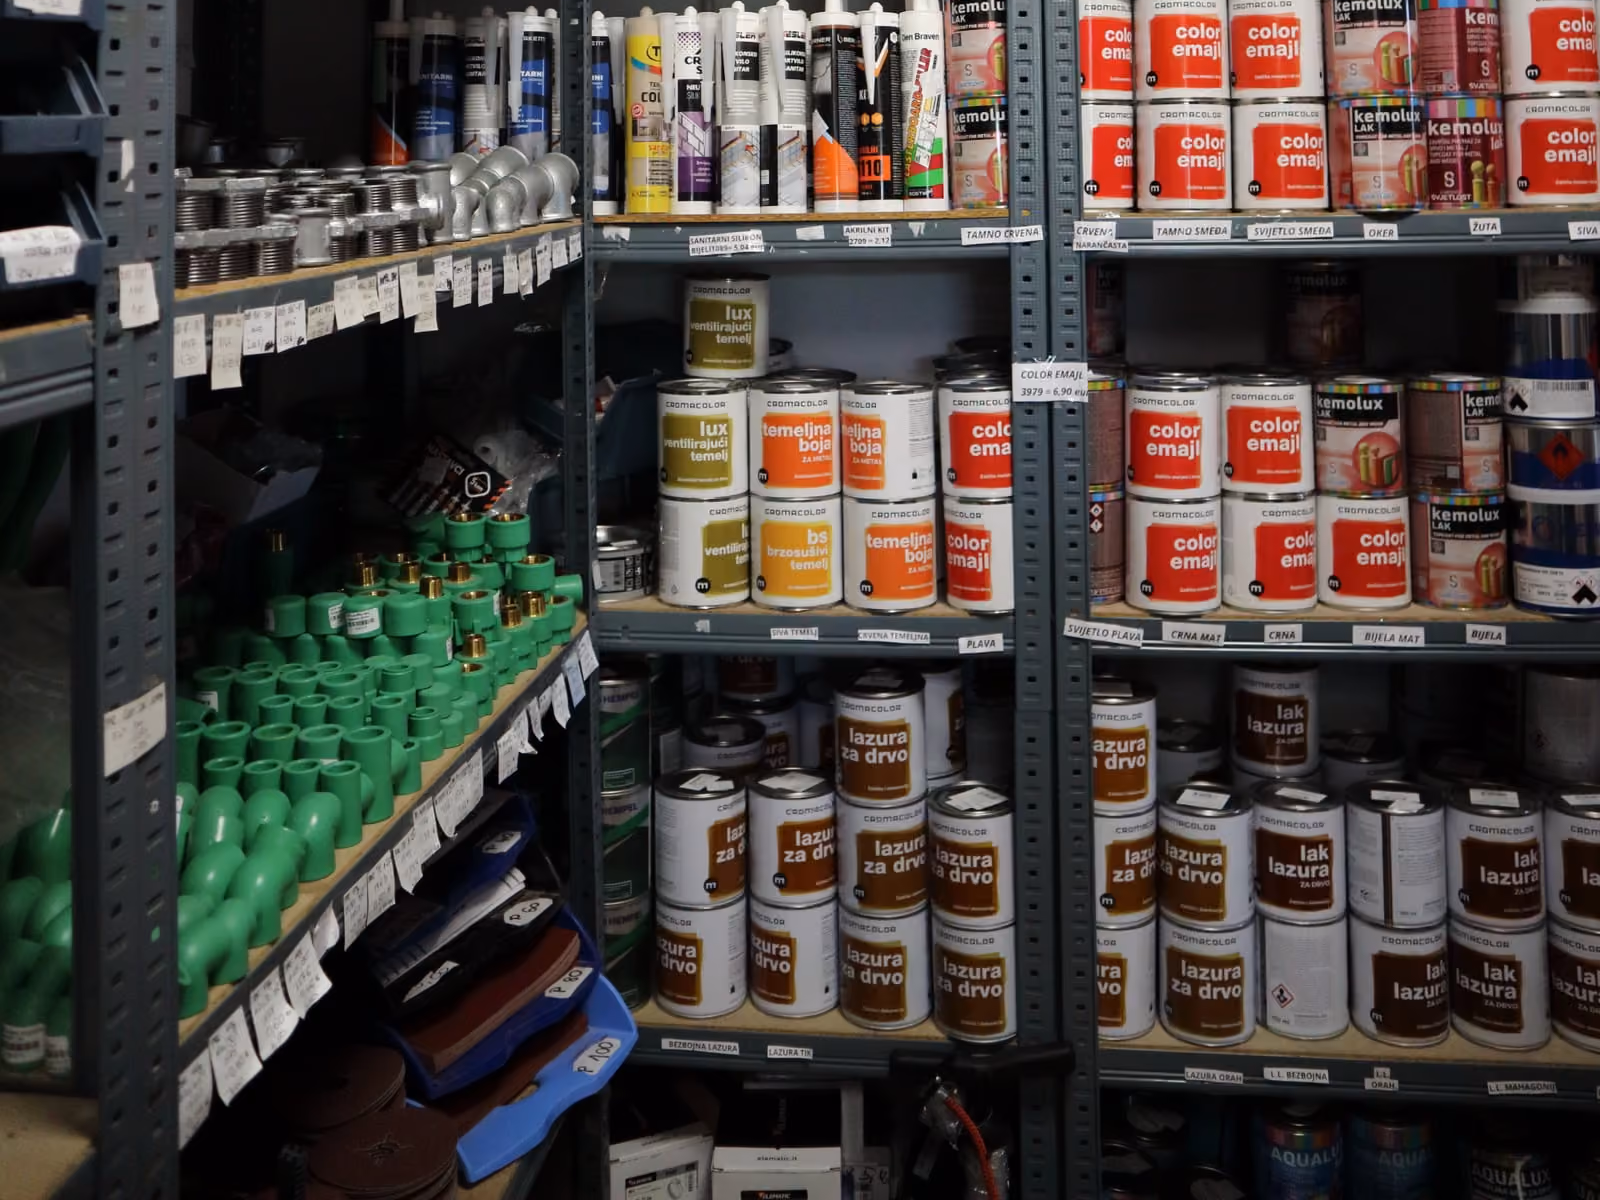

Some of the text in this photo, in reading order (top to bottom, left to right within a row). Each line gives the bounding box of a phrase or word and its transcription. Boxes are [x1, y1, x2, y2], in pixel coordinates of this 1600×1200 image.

[914, 32, 940, 41] Braven
[1175, 23, 1221, 41] color
[1248, 23, 1299, 41] color
[1172, 42, 1222, 61] emajl
[1245, 42, 1300, 61] emajl
[953, 108, 1006, 125] kemolu
[1353, 109, 1421, 123] kemolux
[1353, 123, 1375, 133] LAK
[1547, 128, 1596, 145] color
[1180, 133, 1225, 150] color
[1280, 133, 1323, 151] color
[967, 227, 1040, 239] TAMNO CRVENA
[1157, 226, 1190, 237] TAMNO
[1254, 226, 1297, 237] SVIJETLO
[1368, 228, 1394, 238] OKER
[1472, 221, 1498, 232] ŽUTA
[1576, 226, 1598, 236] SIVA
[725, 305, 753, 322] lux
[716, 333, 753, 346] temelj
[1020, 369, 1084, 381] COLOR EMAJL
[1020, 387, 1043, 398] 3979
[700, 420, 728, 438] lux
[761, 421, 832, 441] temeljna
[1149, 422, 1200, 439] color
[1249, 416, 1299, 433] color
[798, 437, 832, 454] boja
[850, 440, 882, 456] boja
[1145, 440, 1200, 458] emajl
[1246, 434, 1300, 453] emajl
[690, 450, 729, 463] temelj
[1431, 507, 1500, 522] kemolux
[1432, 521, 1452, 531] LAK
[807, 528, 828, 546] bs
[866, 531, 933, 551] temeljna
[1173, 535, 1217, 551] color
[1359, 530, 1405, 547] color
[790, 557, 829, 571] temelj
[904, 548, 933, 564] boja
[1067, 623, 1142, 642] SVIJETLO PLAVA
[1170, 629, 1222, 643] CRNA MAT
[1268, 629, 1296, 641] CRNA
[1364, 632, 1421, 645] BIJELA MAT
[1471, 629, 1502, 642] BIJELA
[966, 637, 996, 649] PLAVA
[1276, 703, 1305, 719] lak
[848, 727, 908, 746] lazura
[865, 745, 909, 764] drvo
[1104, 752, 1146, 770] drvo
[784, 848, 806, 863] za
[1299, 843, 1329, 862] lak
[1513, 850, 1539, 867] lak
[863, 859, 887, 875] za
[948, 866, 993, 885] drvo
[1178, 863, 1224, 885] drvo
[1268, 855, 1330, 879] lazura
[1479, 865, 1539, 885] lazura
[943, 956, 1002, 979] lazura
[1180, 959, 1242, 981] lazura
[1483, 961, 1517, 981] lak
[859, 967, 904, 986] drvo
[957, 978, 1002, 998] drvo
[1198, 979, 1242, 1000] drvo
